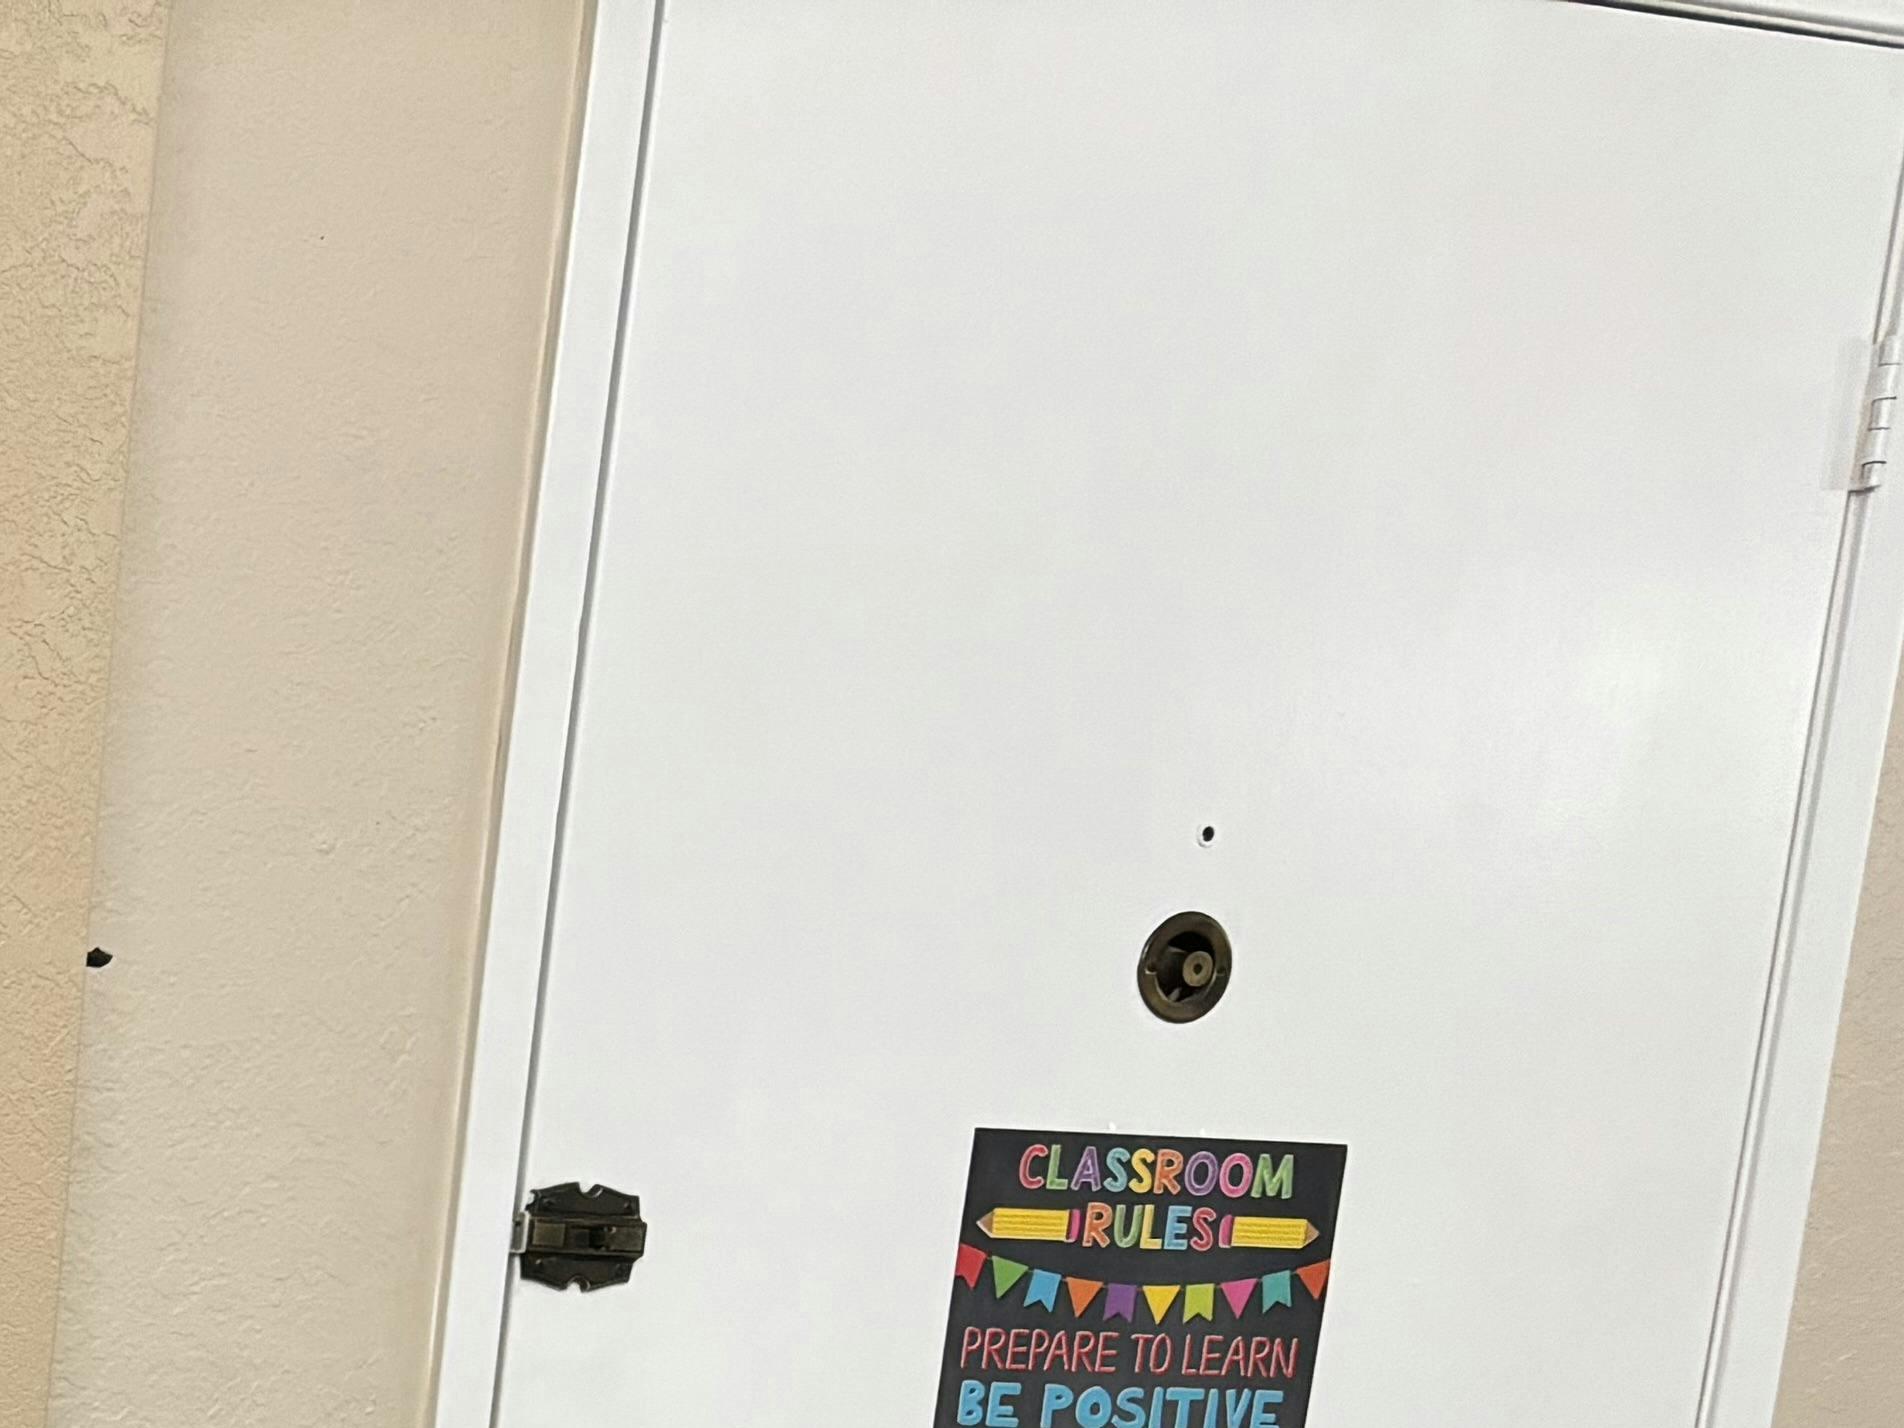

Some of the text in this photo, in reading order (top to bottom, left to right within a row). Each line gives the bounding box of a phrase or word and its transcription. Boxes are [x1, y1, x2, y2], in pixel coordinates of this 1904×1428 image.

[1019, 1143, 1295, 1199] CLASSROOM
[1082, 1202, 1218, 1251] RULES
[960, 1327, 1299, 1379] PREPARE TO LEARN
[957, 1380, 1023, 1428] BE
